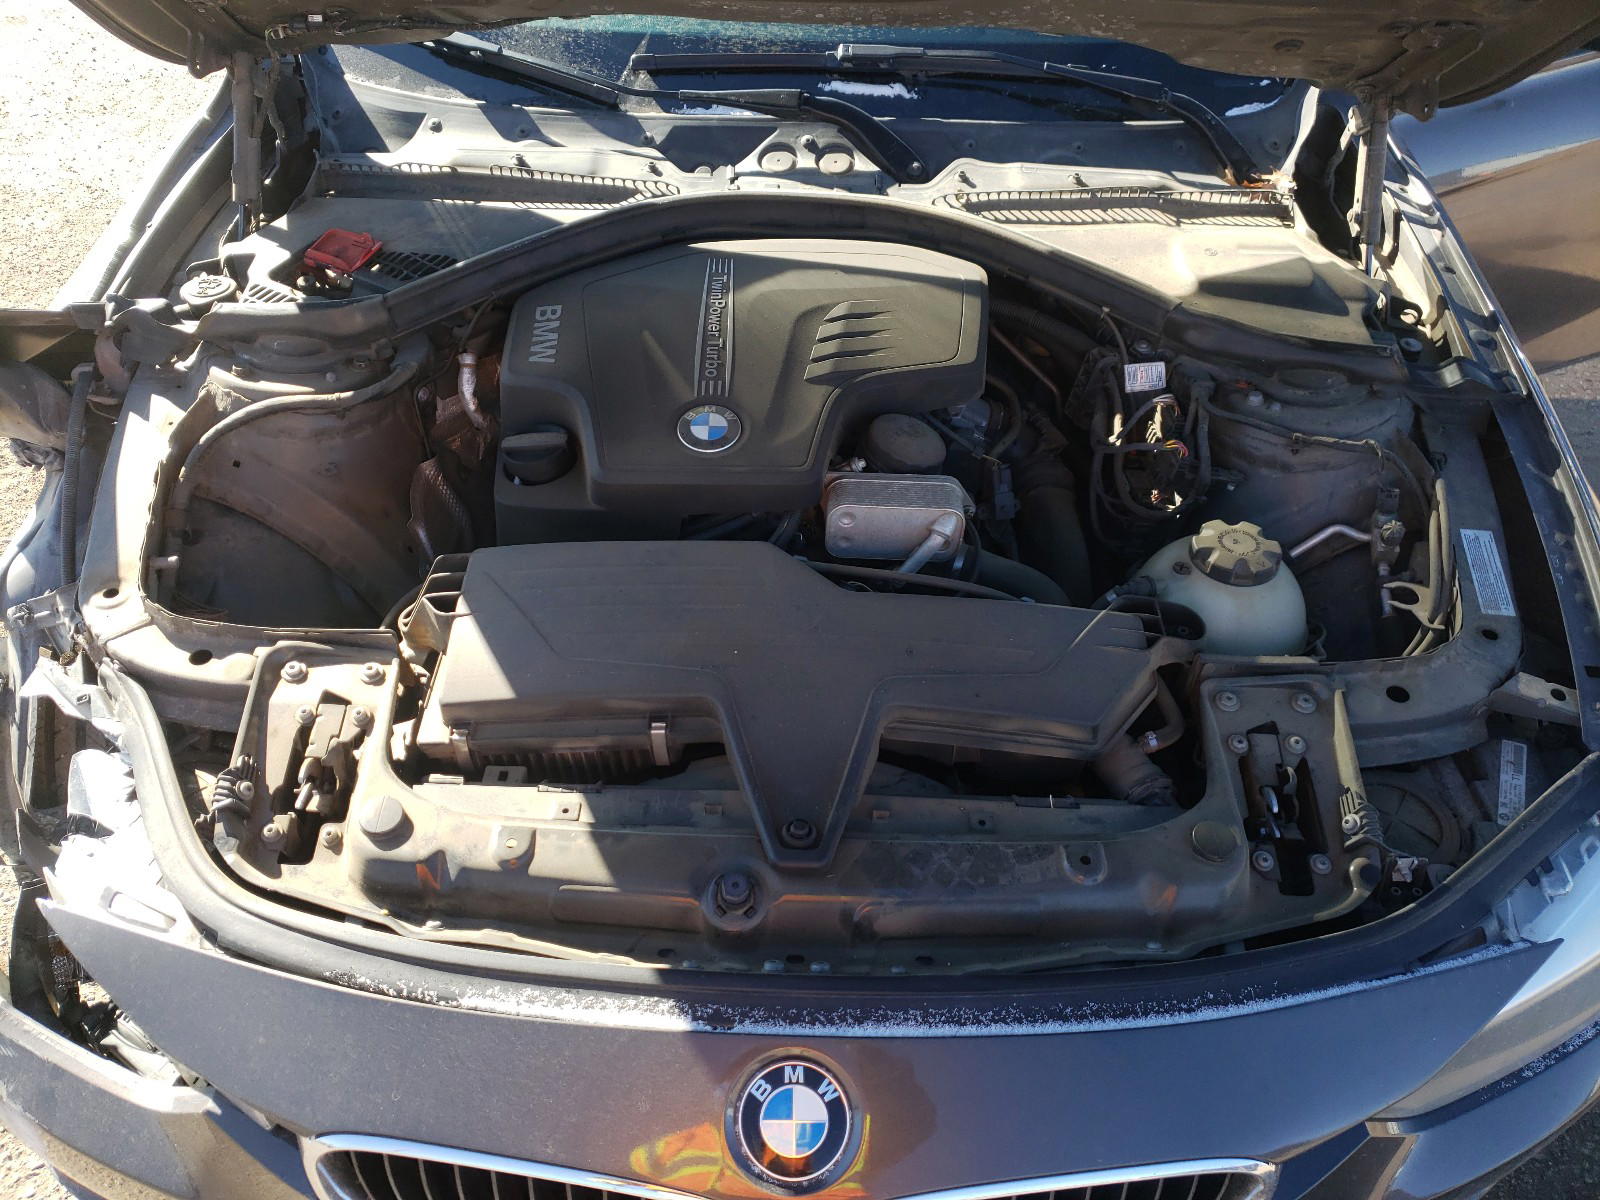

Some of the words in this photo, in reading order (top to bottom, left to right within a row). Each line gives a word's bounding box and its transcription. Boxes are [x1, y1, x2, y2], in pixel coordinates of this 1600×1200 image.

[707, 274, 728, 337] TwinPower
[528, 304, 562, 363] BMW
[704, 338, 724, 378] Turbo
[684, 405, 736, 421] BMW
[750, 1065, 840, 1103] BMW
